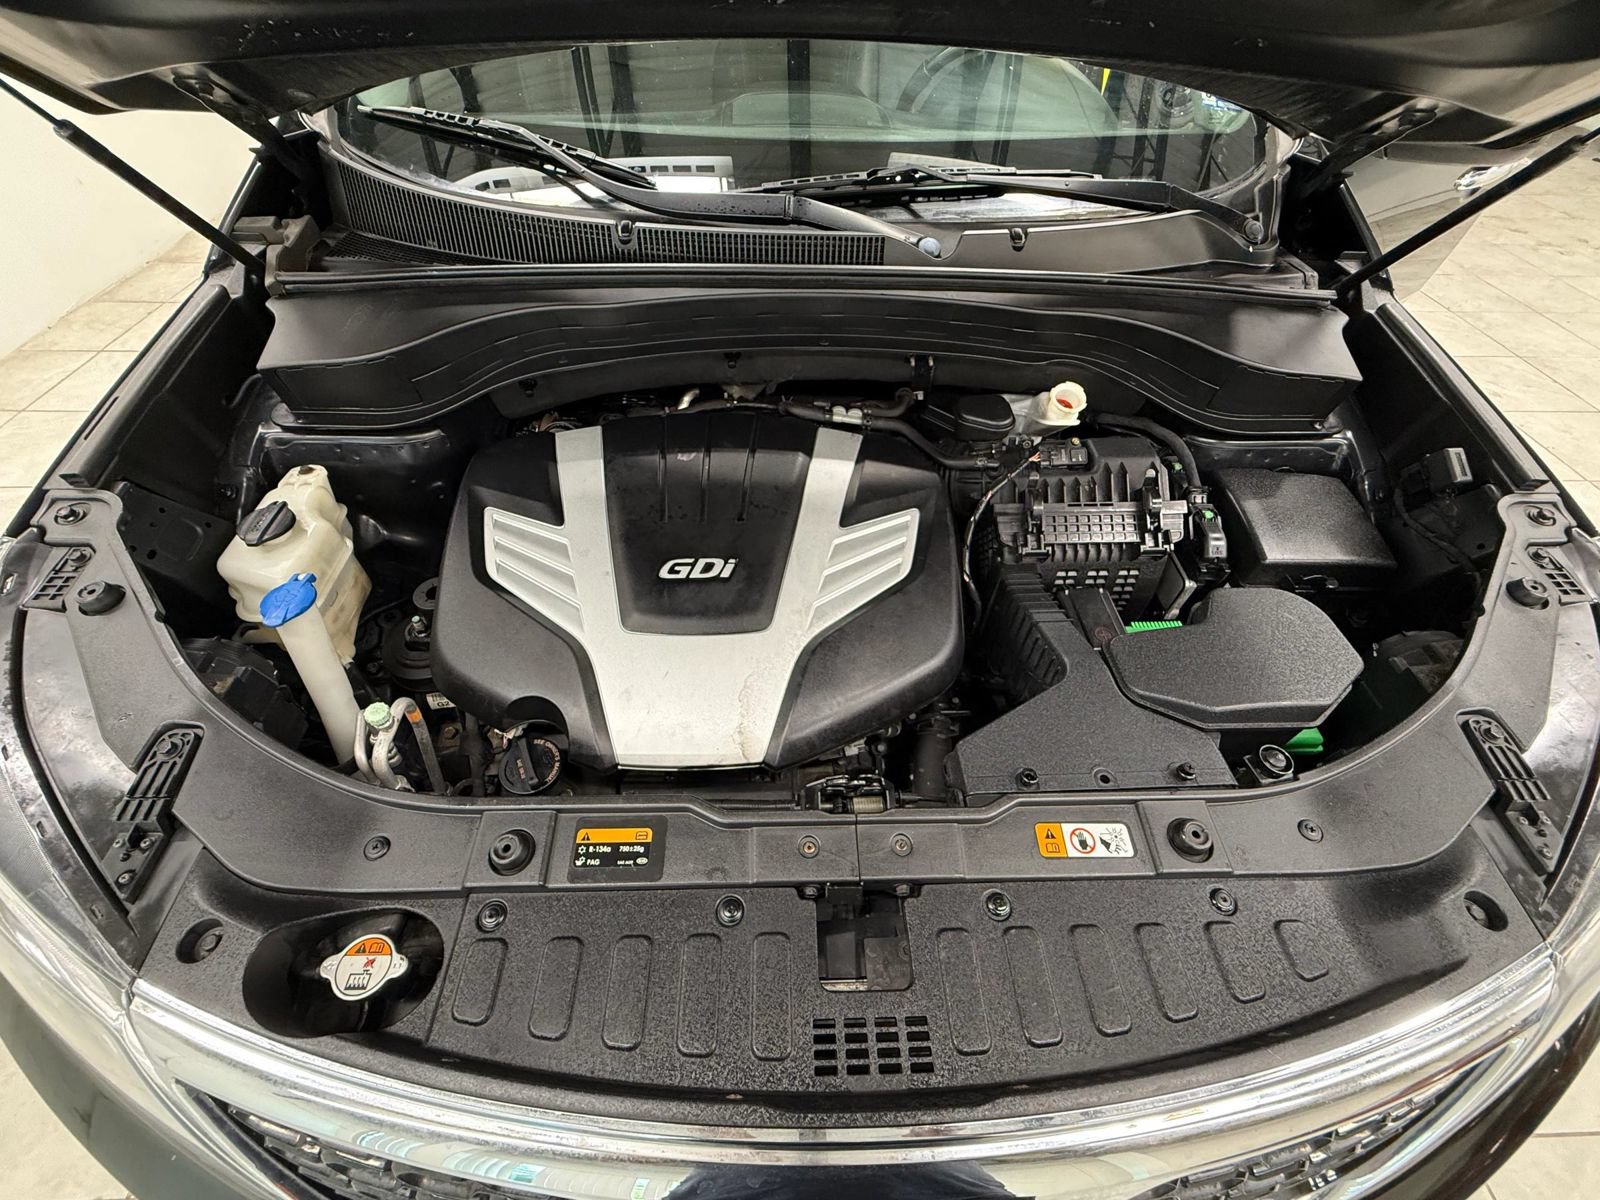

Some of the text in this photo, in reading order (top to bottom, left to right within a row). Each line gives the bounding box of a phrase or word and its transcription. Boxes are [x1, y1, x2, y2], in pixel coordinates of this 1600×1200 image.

[658, 557, 739, 579] GDi
[588, 845, 612, 853] R-134a
[586, 858, 600, 866] PAG
